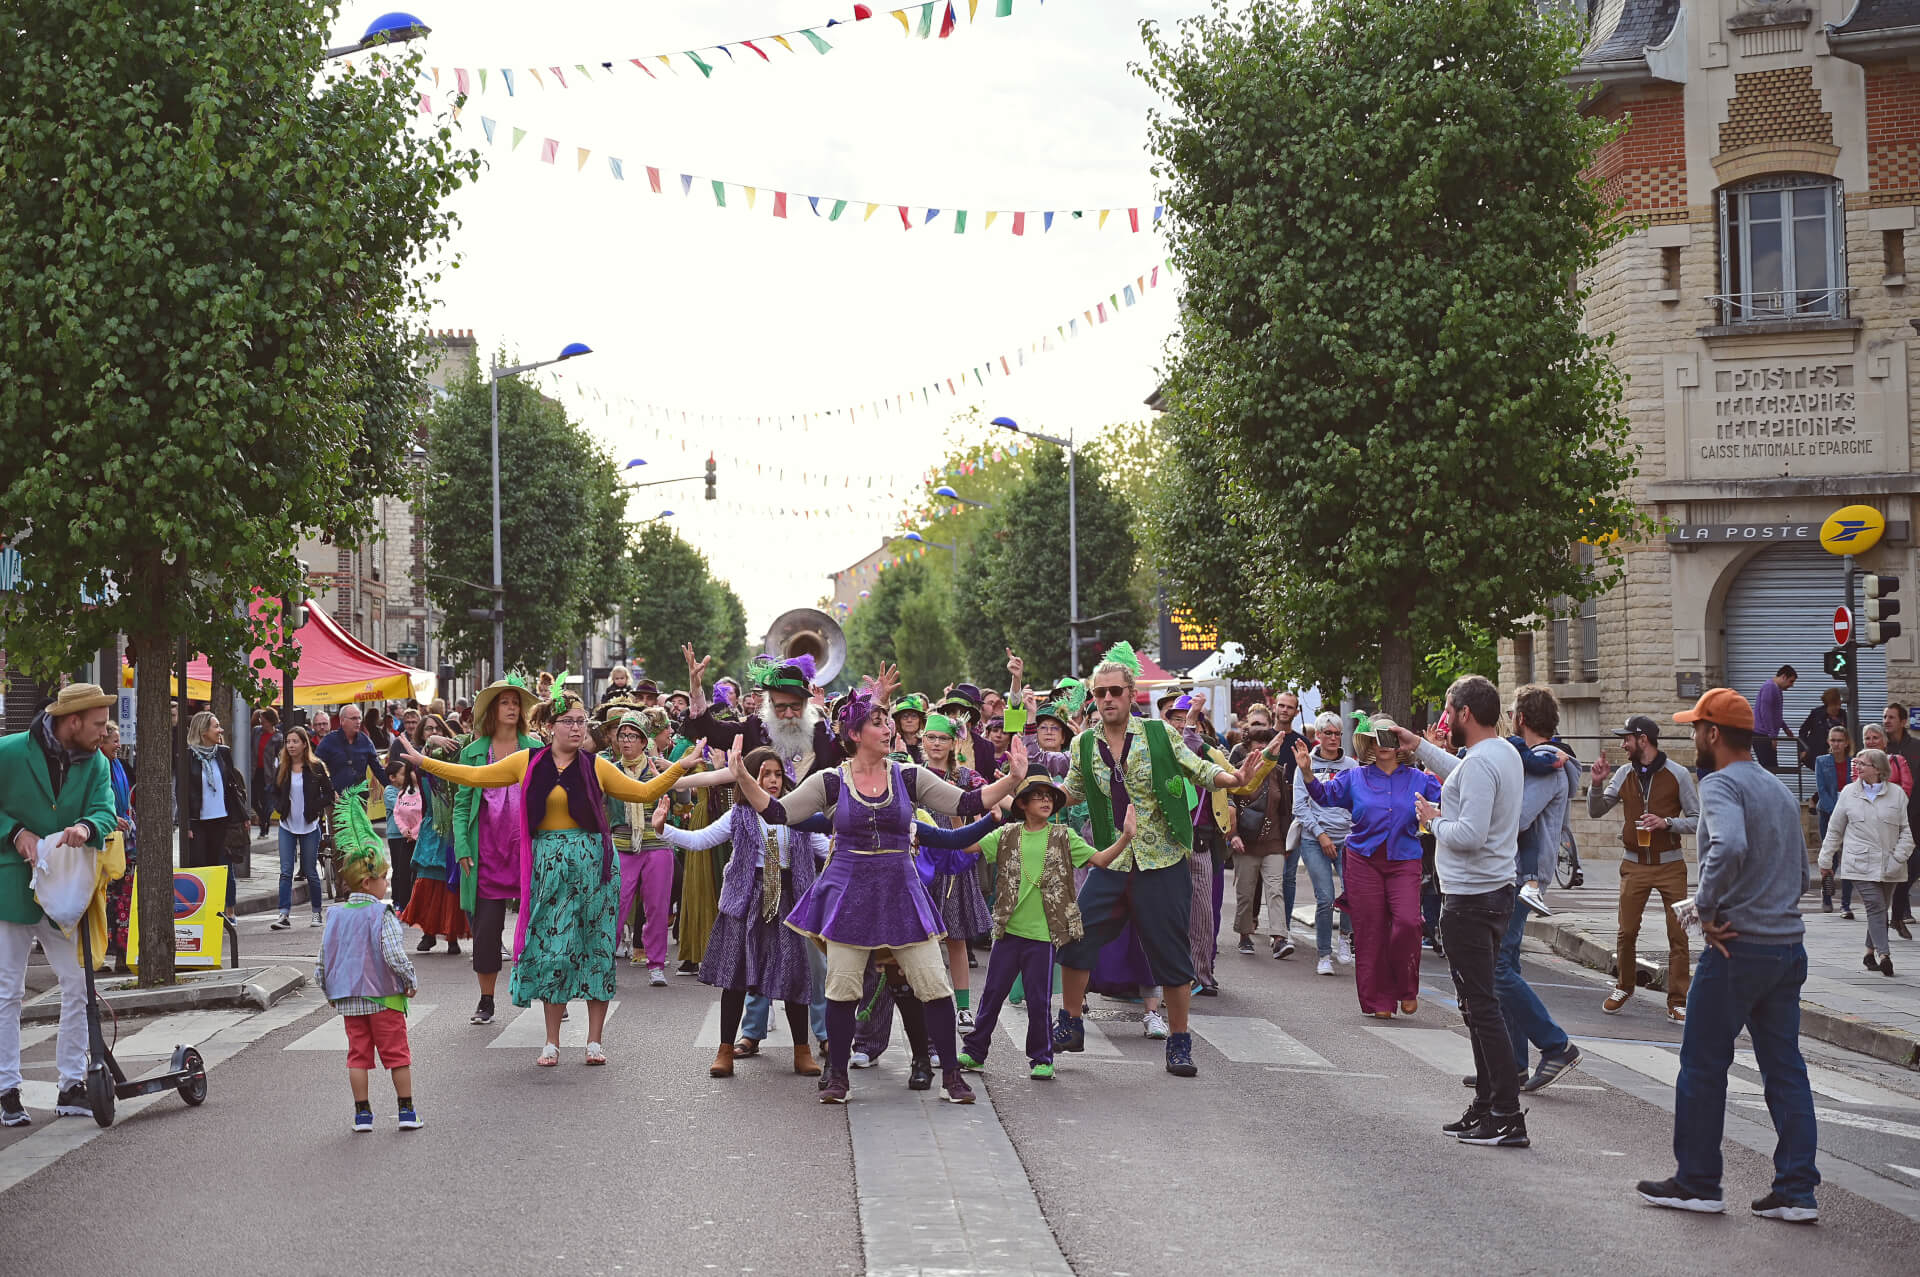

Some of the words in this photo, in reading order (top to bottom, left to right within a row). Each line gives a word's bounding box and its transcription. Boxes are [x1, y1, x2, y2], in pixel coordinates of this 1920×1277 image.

[1731, 366, 1840, 391] POSTES
[1716, 393, 1855, 416] TELEGRAPHES
[1717, 416, 1856, 439] TELEPHONES
[1701, 444, 1740, 459] CAISSE
[1743, 442, 1805, 457] NATIONALE
[1679, 528, 1709, 539] LA
[1726, 526, 1809, 538] POSTE
